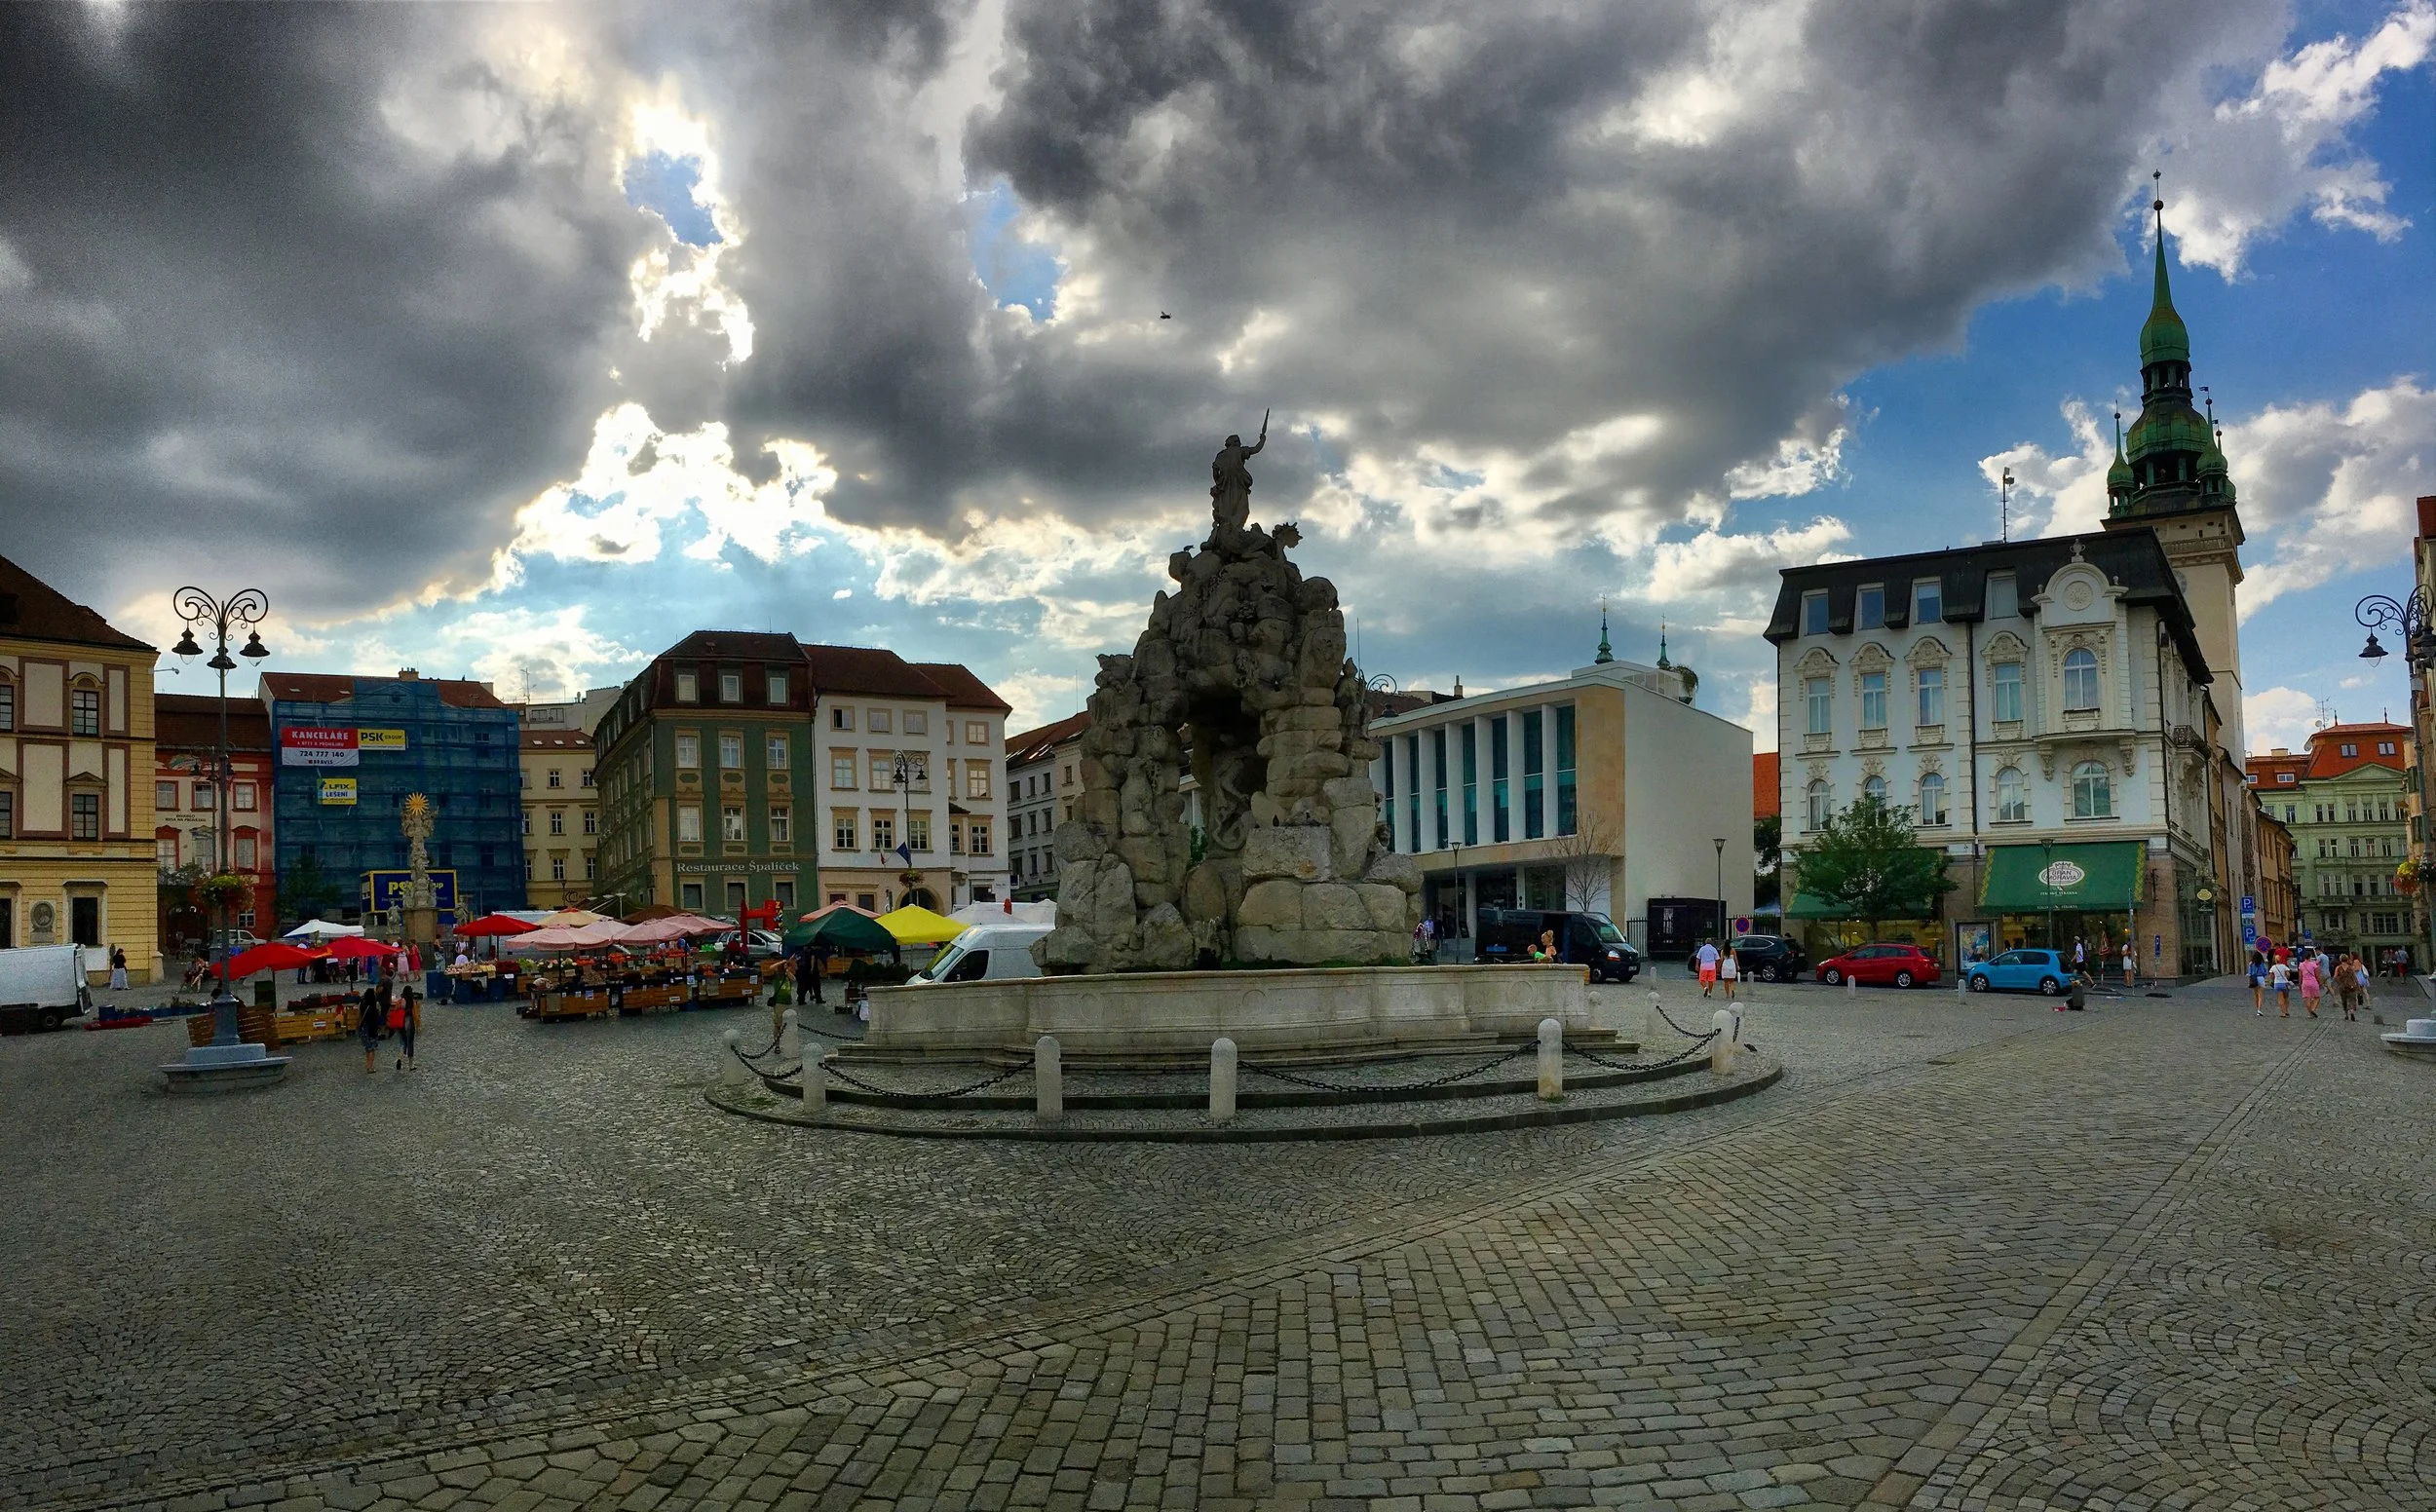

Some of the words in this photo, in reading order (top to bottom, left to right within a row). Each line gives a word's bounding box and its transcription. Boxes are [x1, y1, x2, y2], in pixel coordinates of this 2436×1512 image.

[361, 732, 384, 741] PSK
[676, 862, 745, 873] Restaurace
[748, 859, 800, 873] Špalíček
[2243, 898, 2251, 908] P
[2245, 927, 2253, 938] P
